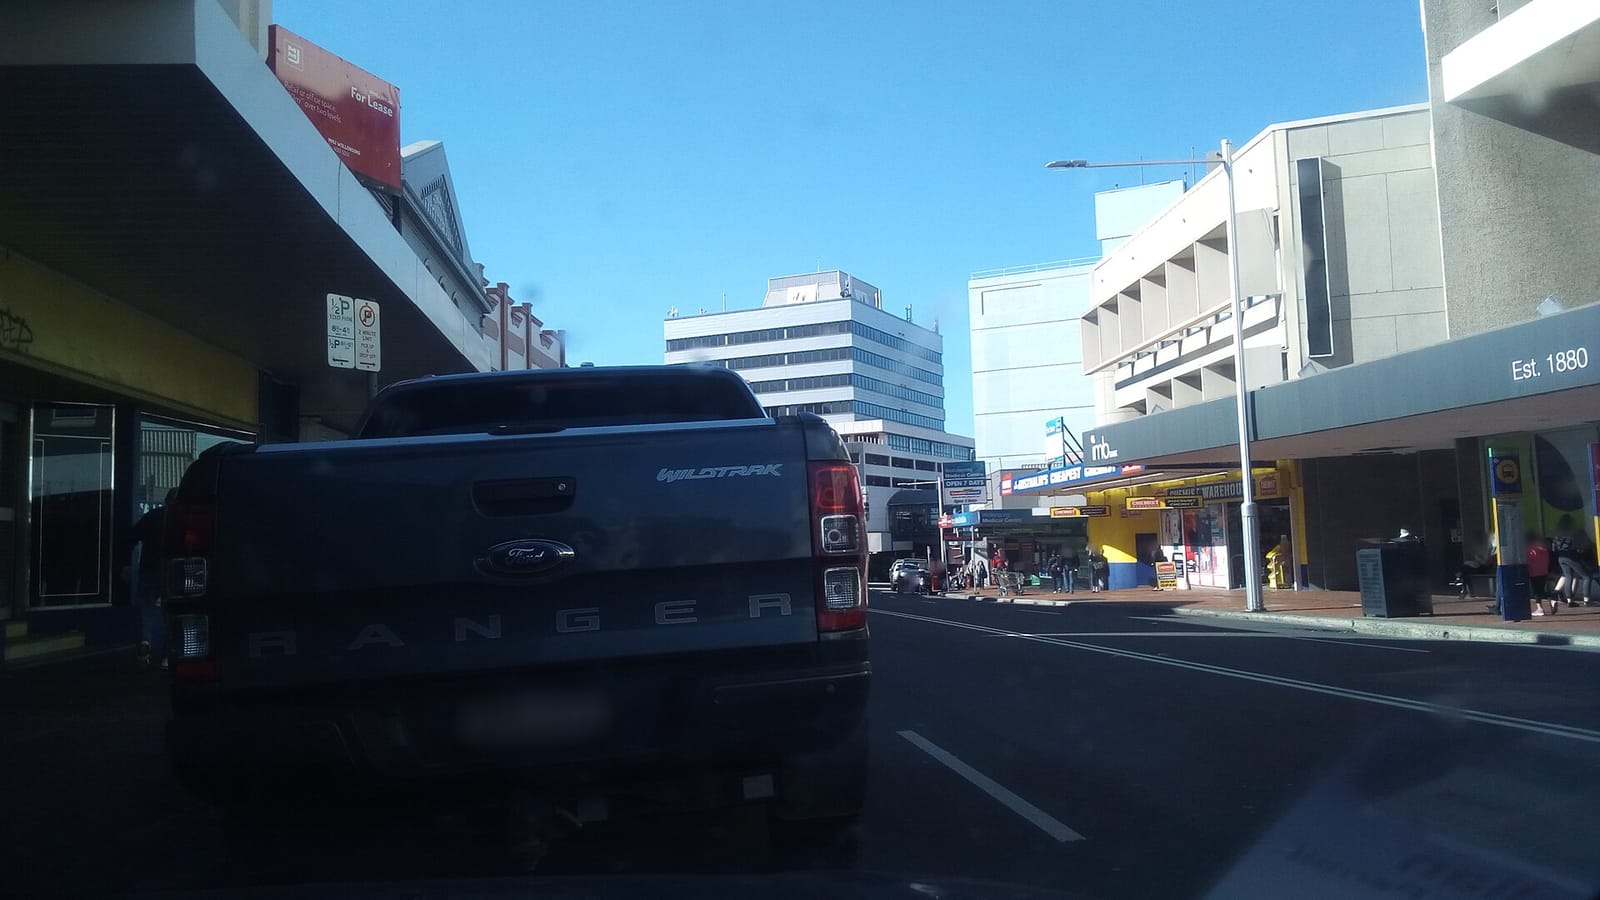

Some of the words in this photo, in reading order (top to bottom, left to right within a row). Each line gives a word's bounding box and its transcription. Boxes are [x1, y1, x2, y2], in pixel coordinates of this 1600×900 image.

[351, 86, 367, 103] For
[367, 94, 393, 117] Lease
[1511, 358, 1541, 381] Est.
[1546, 347, 1588, 374] 1880
[656, 463, 783, 483] WILDTRAK
[1202, 481, 1243, 499] WAREHOU
[508, 547, 545, 560] Ford
[248, 592, 792, 658] RANGER
